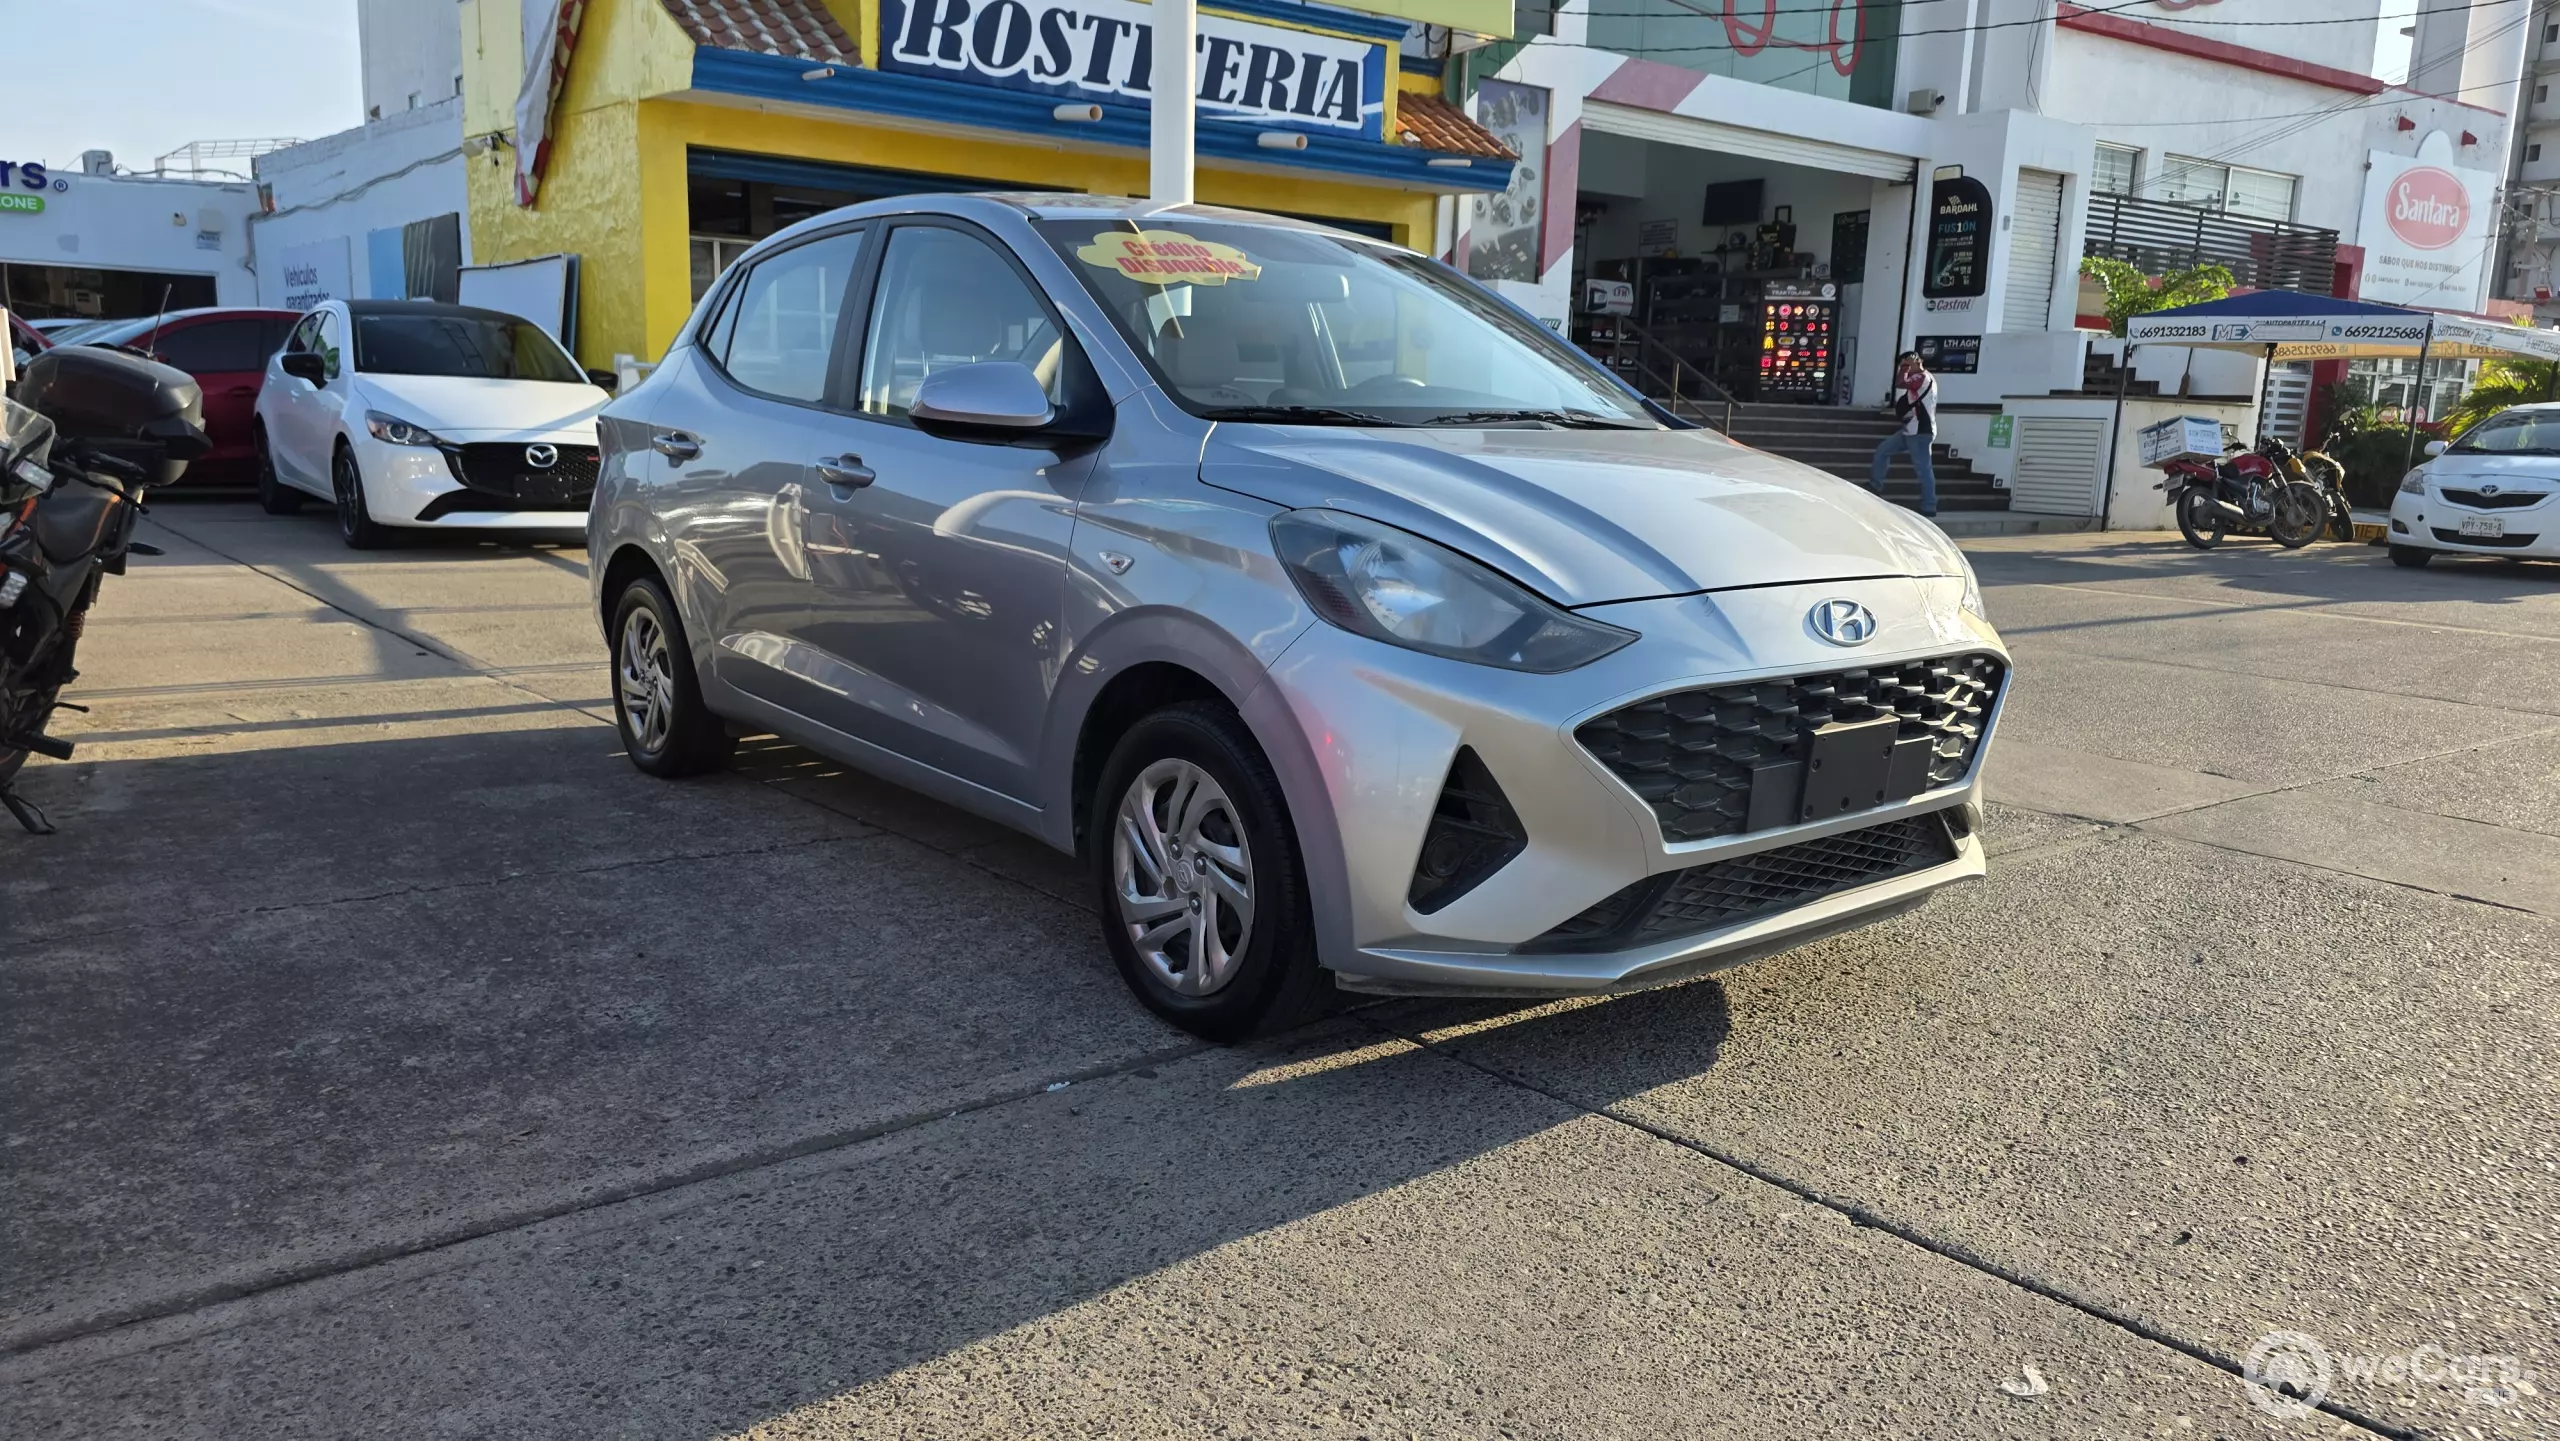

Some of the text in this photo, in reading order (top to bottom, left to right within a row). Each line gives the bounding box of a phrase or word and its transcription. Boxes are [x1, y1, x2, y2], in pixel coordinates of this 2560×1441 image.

[898, 0, 1361, 124] ROSTIERIA
[0, 195, 37, 211] ONE
[1940, 203, 1978, 215] BARDAHL
[2395, 182, 2460, 228] Santara
[1122, 240, 1213, 257] Crédito
[1116, 256, 1246, 275] Disponible
[2379, 255, 2461, 275] SABOR QUE NOS DISTINGUE
[1936, 299, 1971, 311] Castrol
[2139, 326, 2206, 339] 6691332183
[2344, 326, 2424, 340] 6692125686
[1943, 338, 1958, 348] LTH
[1959, 338, 1978, 348] AGM
